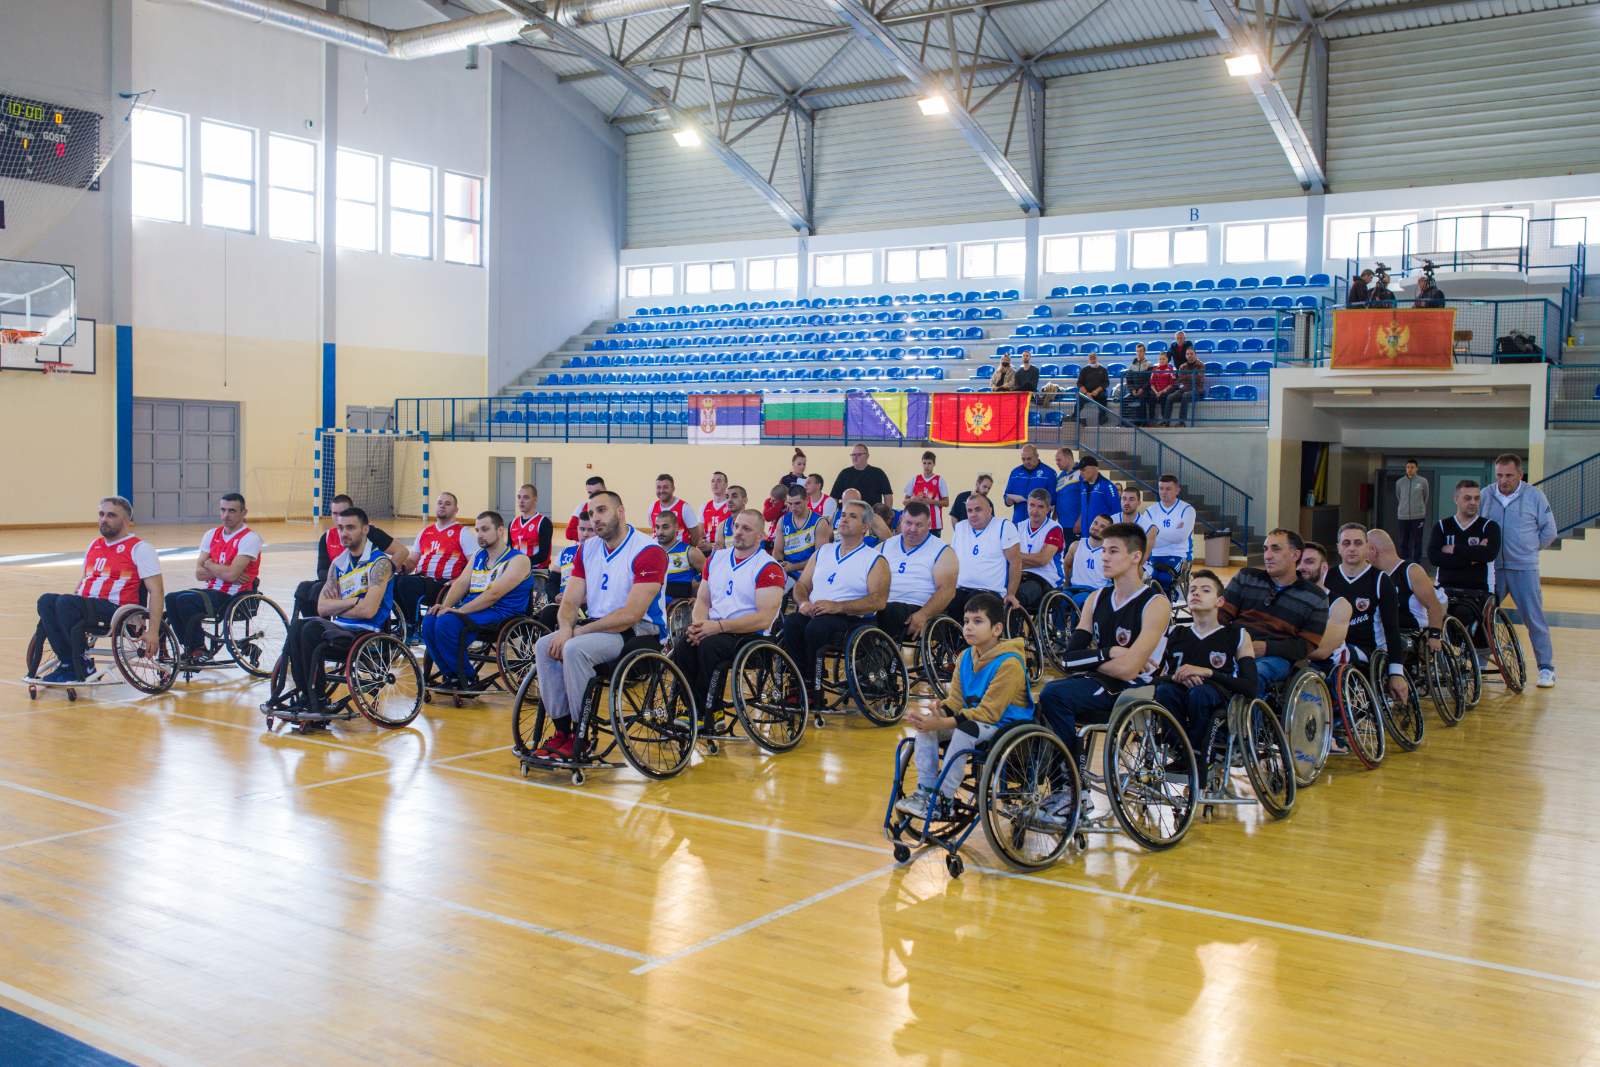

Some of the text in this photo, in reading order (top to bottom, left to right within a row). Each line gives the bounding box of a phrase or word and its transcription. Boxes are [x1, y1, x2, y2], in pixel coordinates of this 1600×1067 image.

[43, 131, 66, 142] GOSTI
[1190, 207, 1199, 221] B
[1162, 519, 1171, 528] 16
[1446, 535, 1455, 545] 11
[972, 544, 979, 556] 6
[94, 557, 107, 571] 10
[898, 562, 907, 573] 5
[1086, 558, 1095, 570] 10
[600, 573, 608, 591] 2
[827, 572, 837, 585] 4
[726, 580, 734, 596] 3
[1173, 652, 1184, 672] 7
